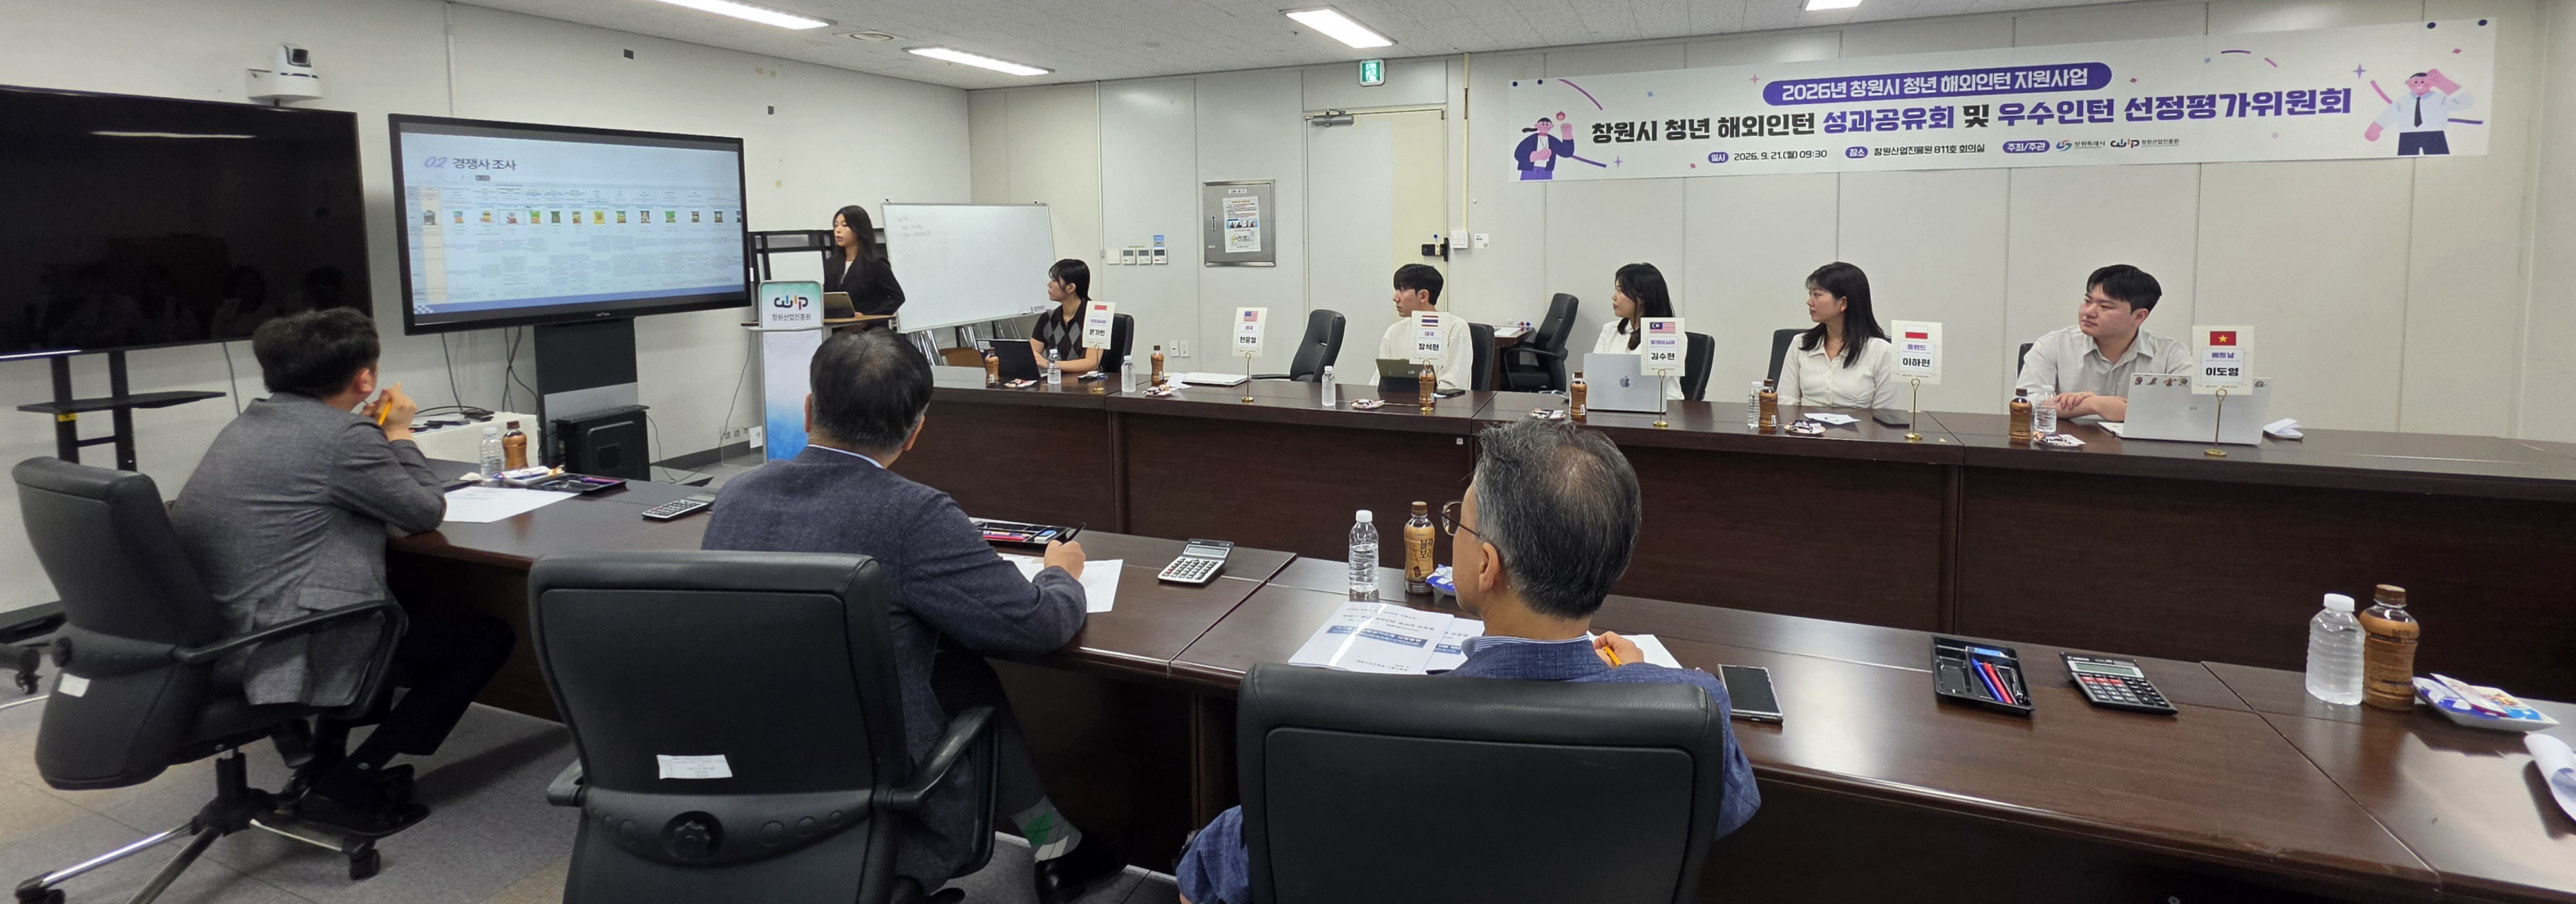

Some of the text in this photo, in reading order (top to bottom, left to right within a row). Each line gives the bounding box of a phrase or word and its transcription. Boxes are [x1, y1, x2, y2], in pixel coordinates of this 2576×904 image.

[1782, 68, 2088, 100] 2026년 창원시 청년 해외인턴 지원사업
[1591, 88, 2352, 144] 창원시 청년 해외인턴 성과공유회 및 우수인턴 선정평가위원회
[1849, 148, 1865, 157] 장소
[1874, 144, 1985, 156] 창원산업진흥원 811호 회의실
[2007, 142, 2046, 153] 주최/주관
[1710, 154, 1725, 162] 일시
[1733, 152, 1759, 161] 2026.
[1761, 152, 1769, 160] 9.
[1799, 149, 1828, 158] 09:30
[424, 156, 516, 171] 02 경쟁사 조사
[772, 313, 811, 321] 창원산업진흥원
[1902, 357, 1930, 368] 이하현
[2206, 367, 2239, 377] 이도영
